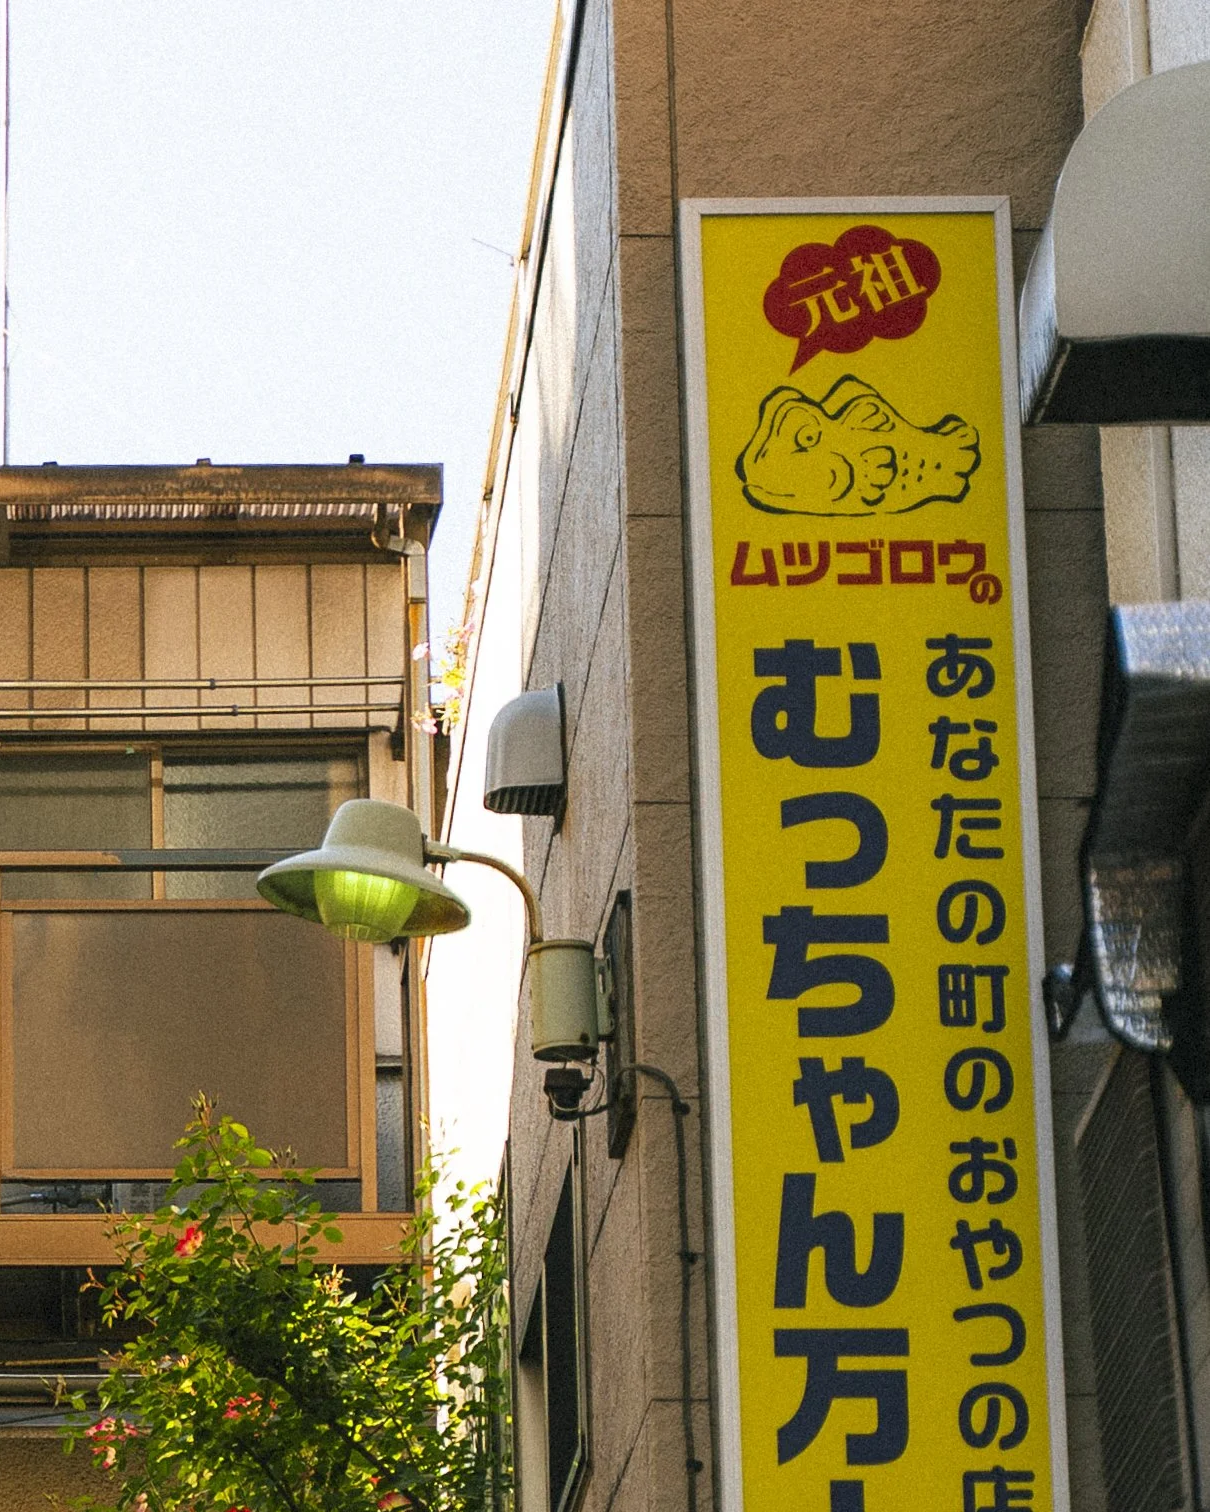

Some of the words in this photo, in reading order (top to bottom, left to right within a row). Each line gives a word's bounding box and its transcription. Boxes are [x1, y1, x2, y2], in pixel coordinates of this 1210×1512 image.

[788, 245, 928, 337] 元祖
[730, 538, 1003, 605] ムツゴロウの
